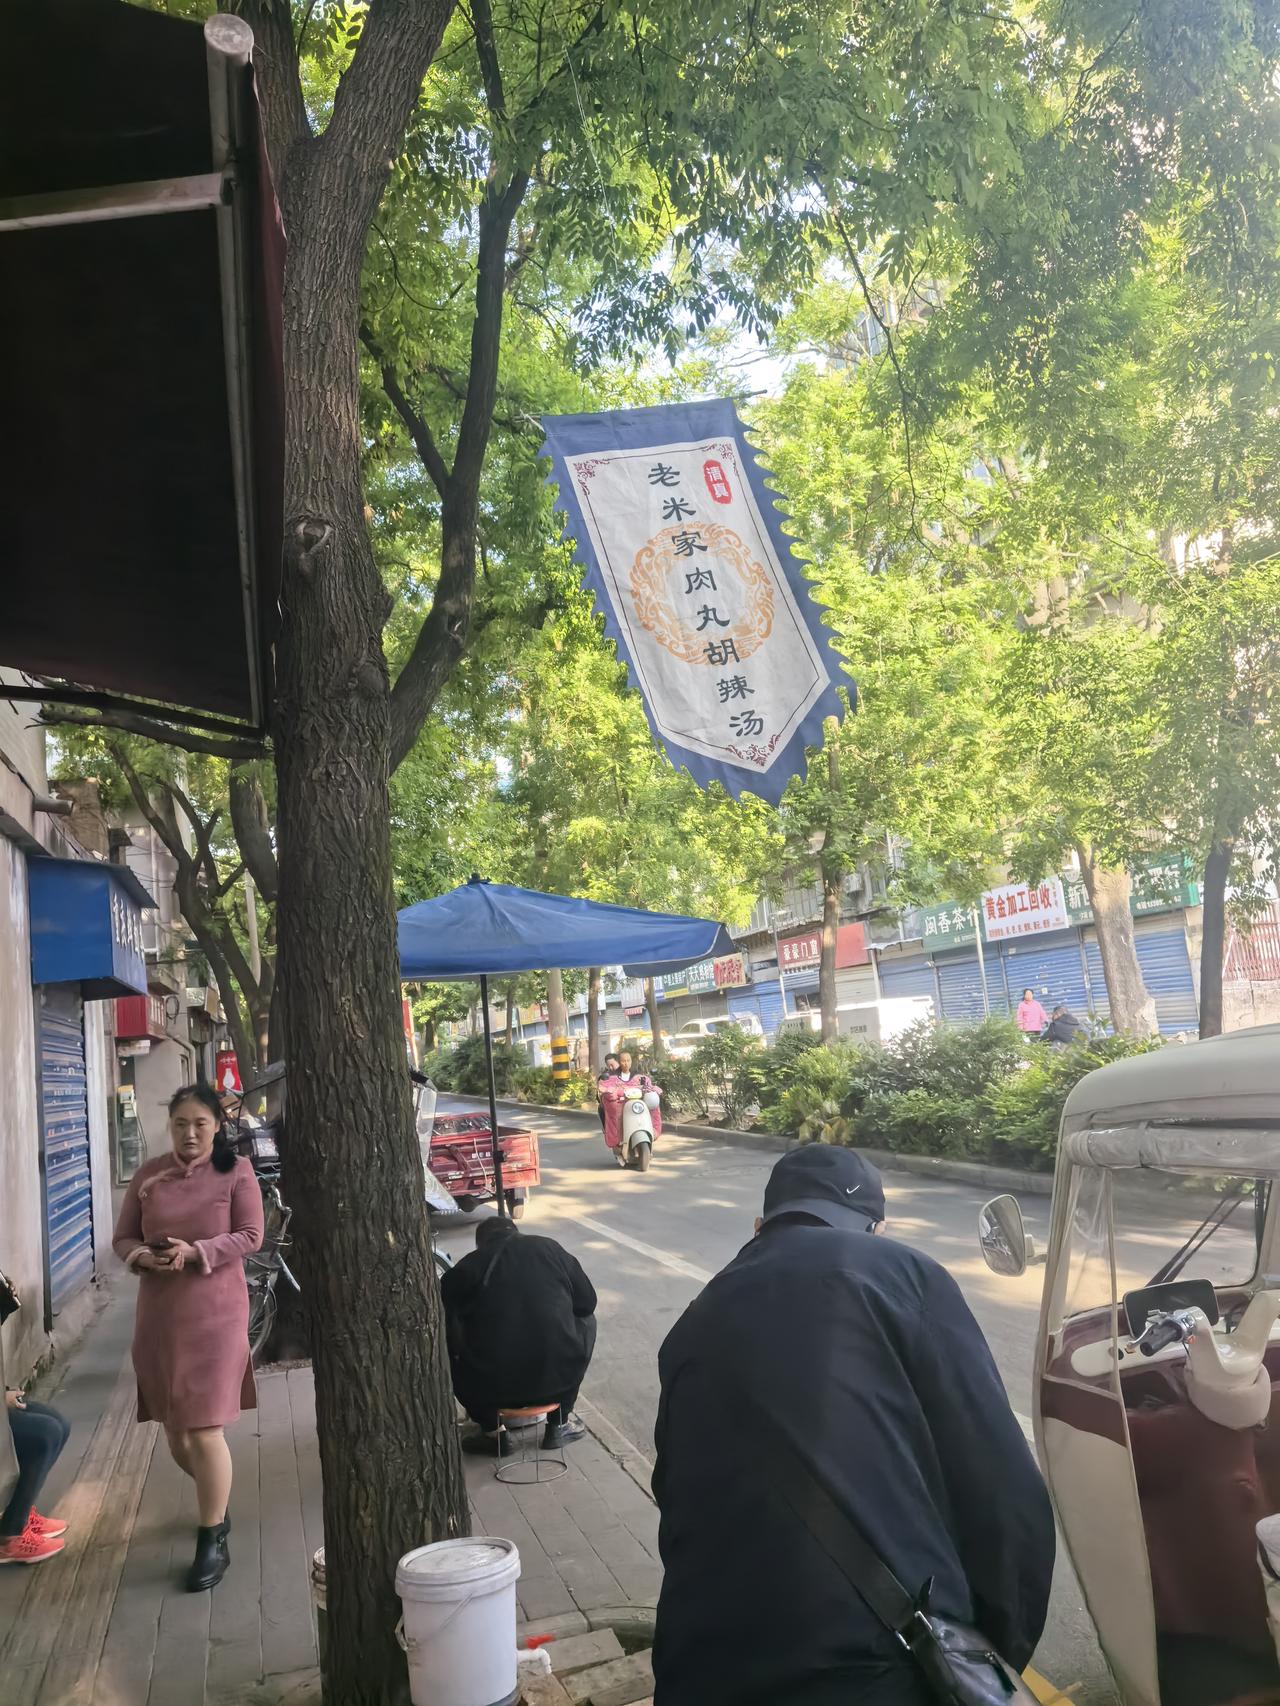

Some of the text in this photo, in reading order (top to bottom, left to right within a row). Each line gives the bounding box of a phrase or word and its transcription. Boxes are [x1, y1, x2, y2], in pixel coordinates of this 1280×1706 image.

[706, 466, 730, 500] 清真
[648, 462, 764, 738] 老米家肉丸胡辣汤
[986, 884, 1052, 920] 黄金加工回收
